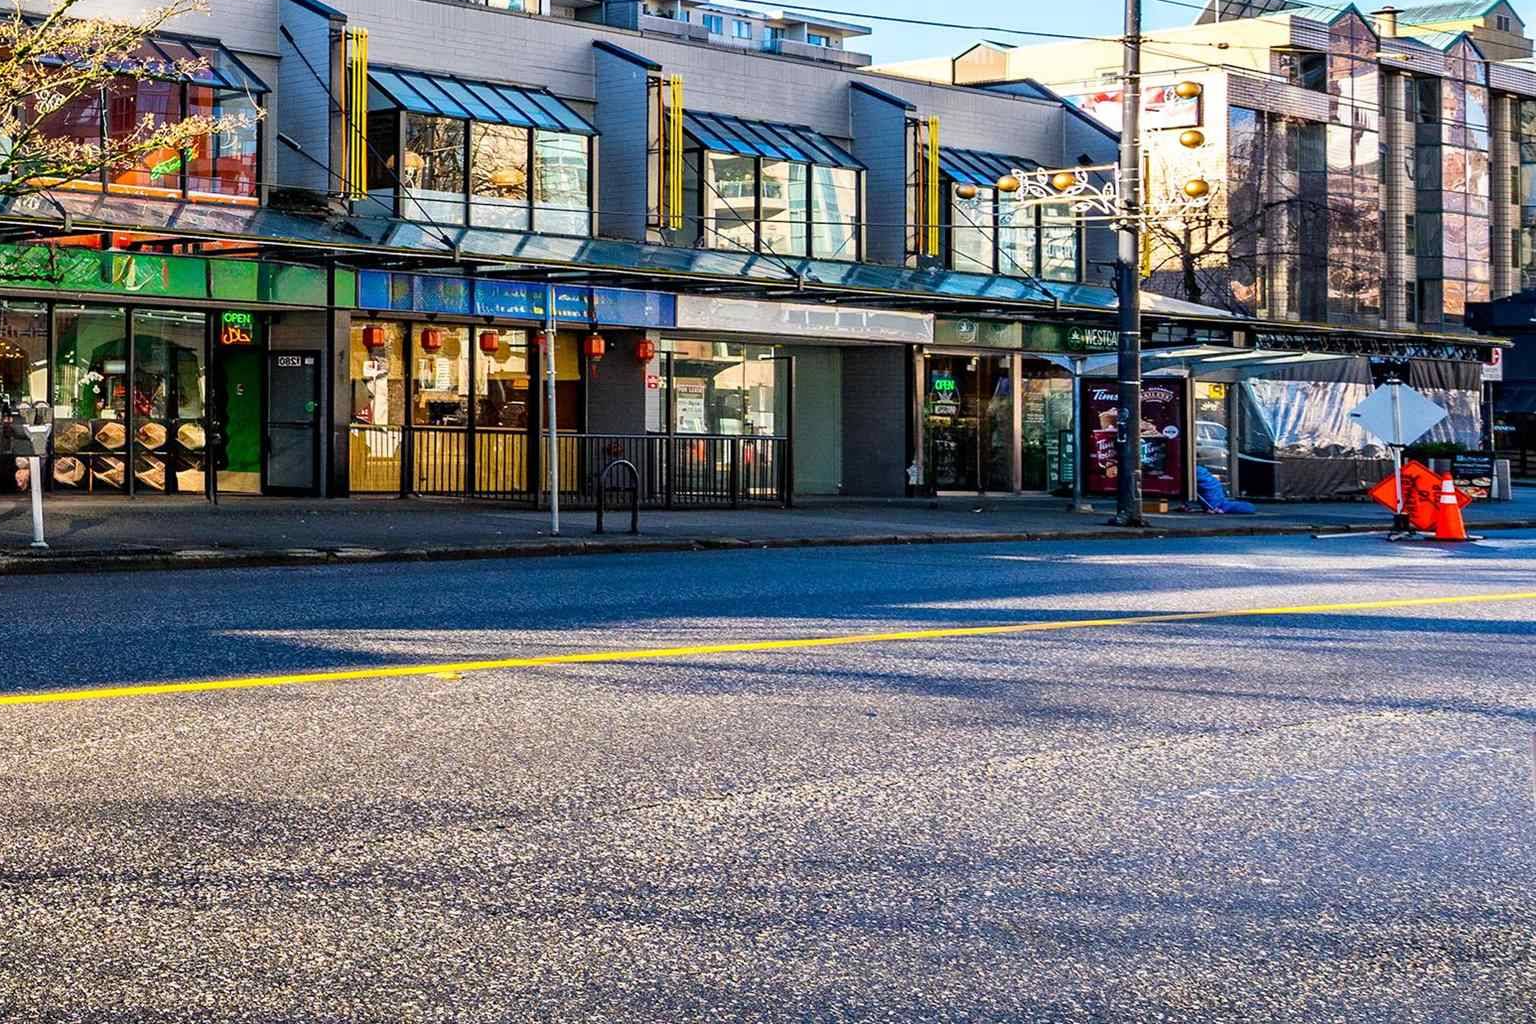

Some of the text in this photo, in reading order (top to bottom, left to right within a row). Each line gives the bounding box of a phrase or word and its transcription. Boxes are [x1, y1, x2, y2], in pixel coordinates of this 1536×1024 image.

[224, 312, 251, 324] OPEN
[223, 326, 251, 345] حلال
[935, 379, 955, 391] OPEN
[1092, 388, 1119, 401] Tims
